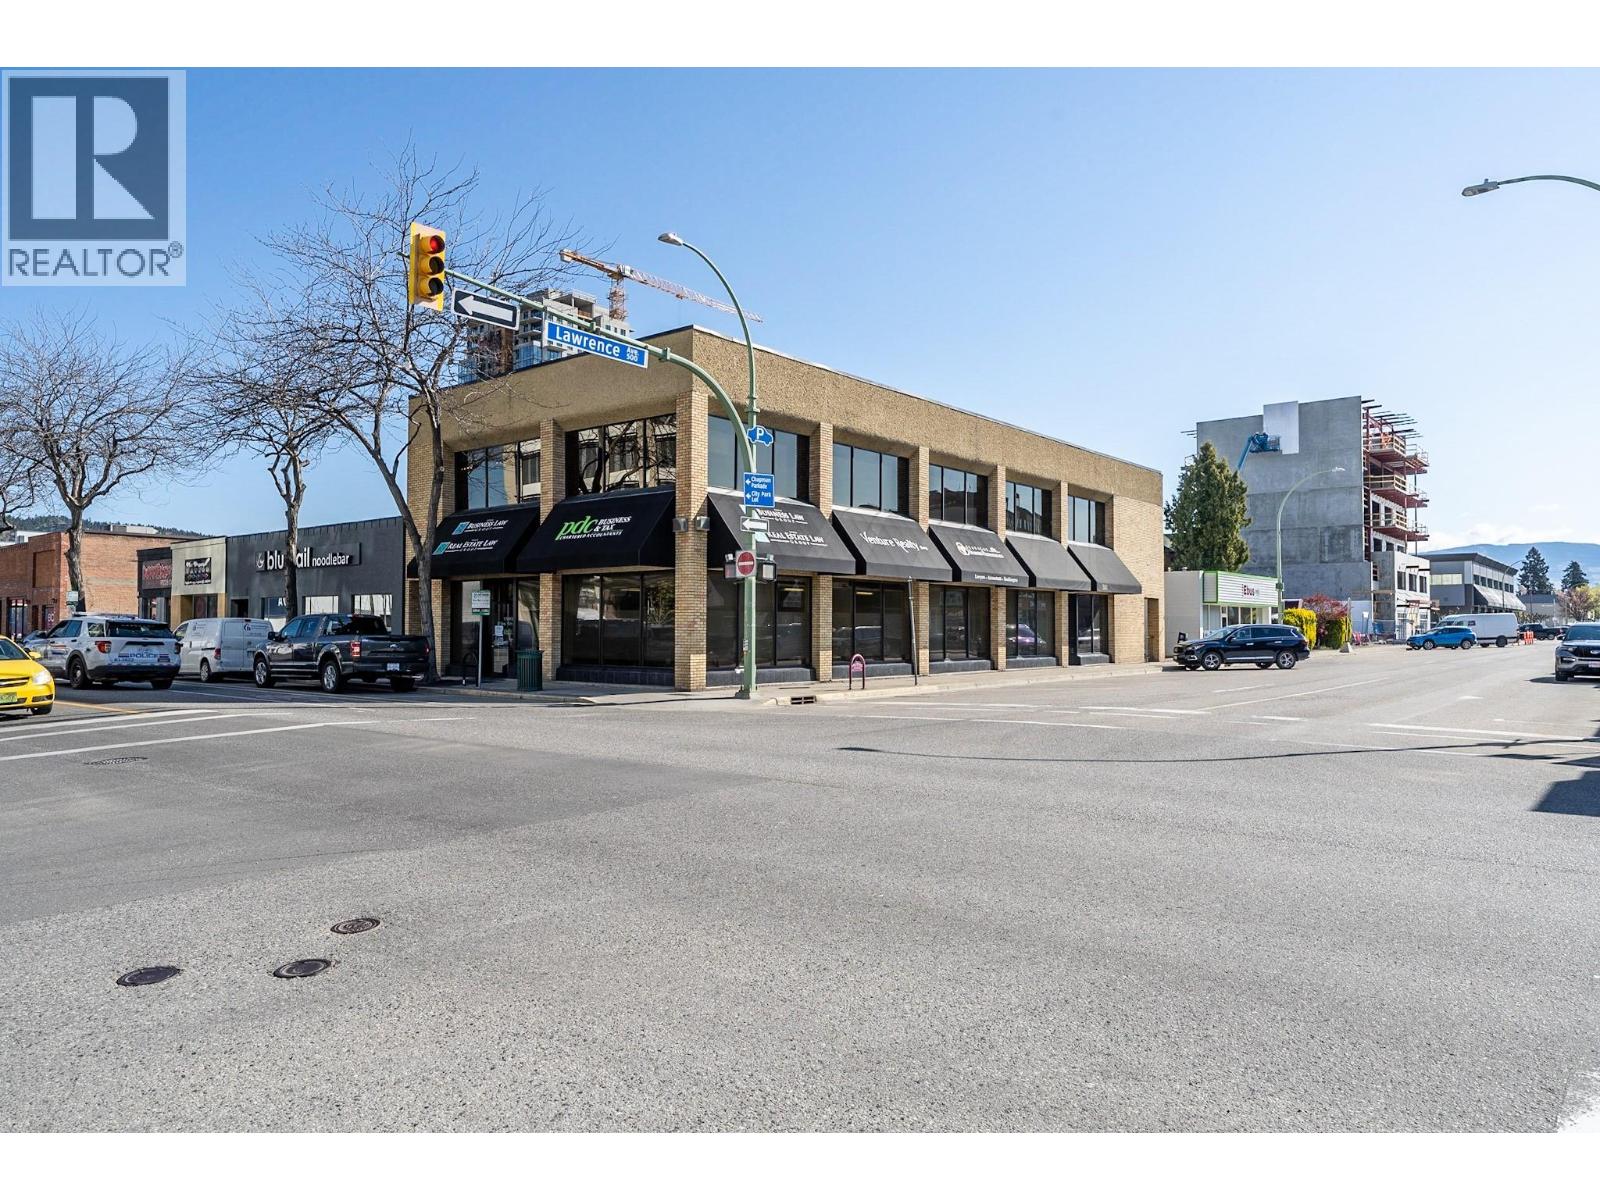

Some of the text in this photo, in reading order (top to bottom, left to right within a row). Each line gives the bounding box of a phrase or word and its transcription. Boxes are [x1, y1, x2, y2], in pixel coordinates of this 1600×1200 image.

[556, 326, 620, 357] Lawrence
[756, 428, 765, 439] P
[751, 476, 771, 484] Chapman
[751, 490, 760, 498] City
[555, 515, 632, 541] pdc BUSINESS
[601, 524, 616, 532] TAX
[860, 531, 920, 553] Venture Realty
[312, 552, 350, 567] noodlebar
[1243, 585, 1255, 596] Ebus
